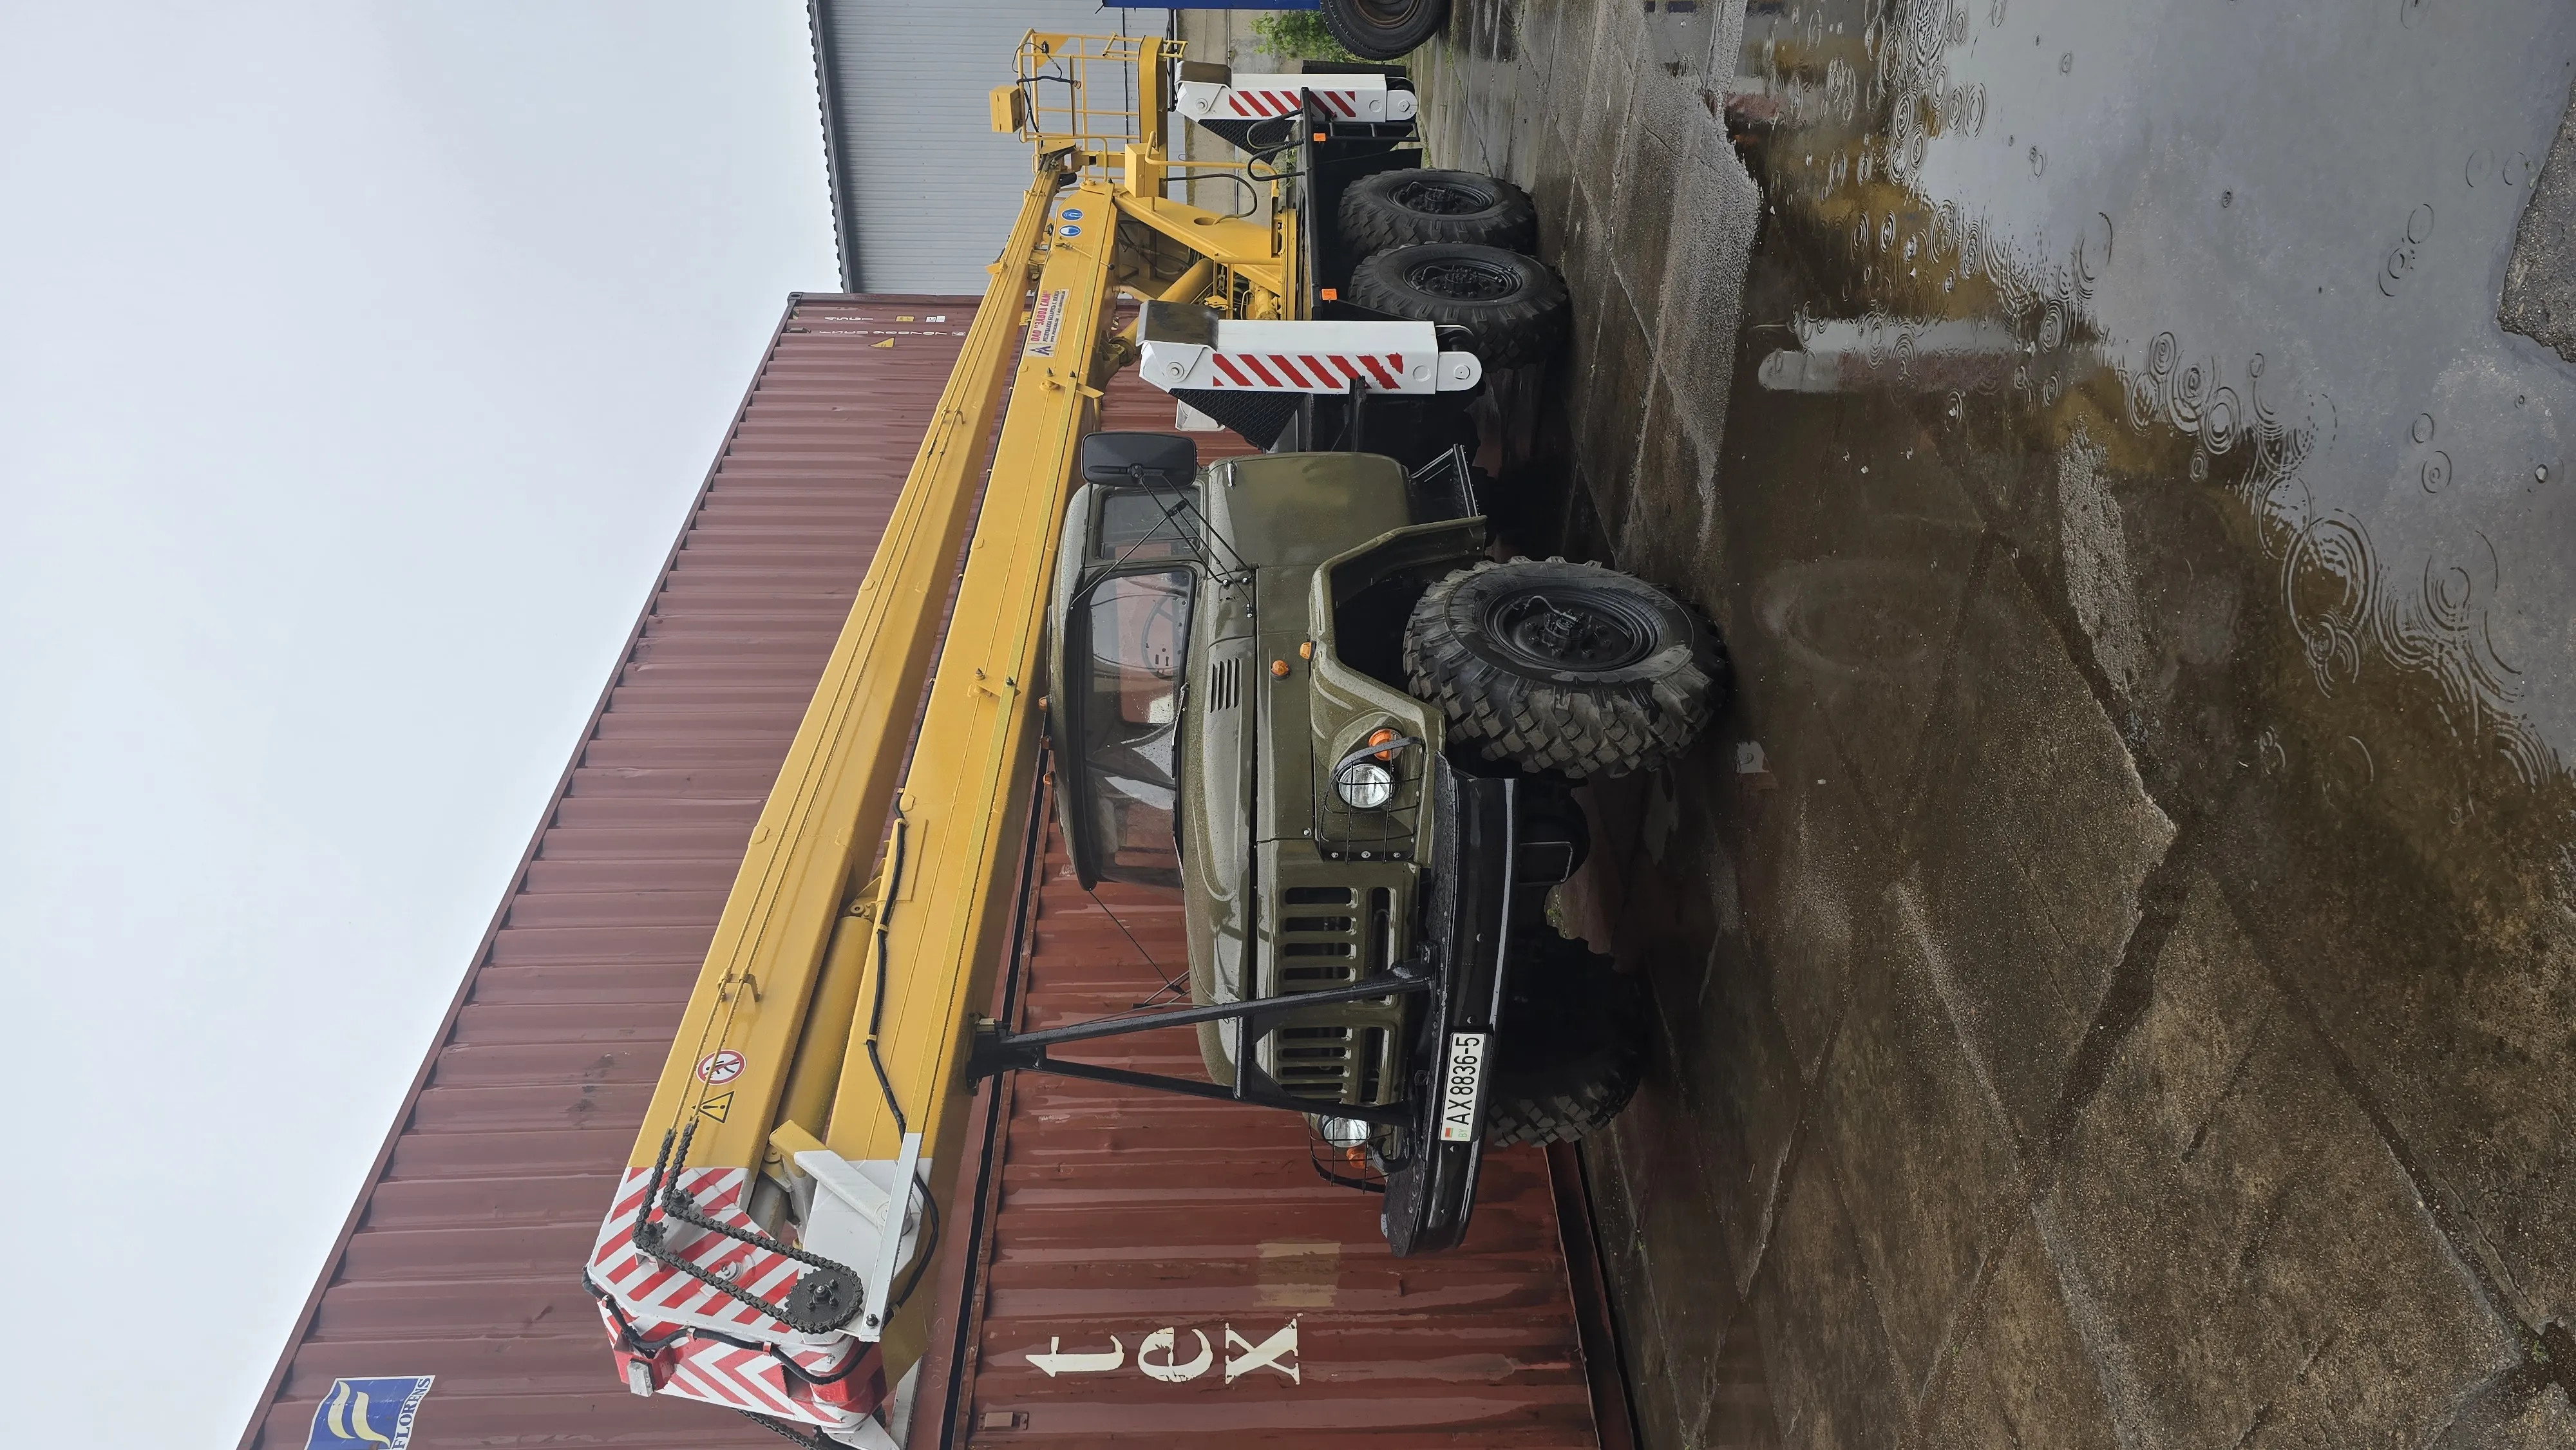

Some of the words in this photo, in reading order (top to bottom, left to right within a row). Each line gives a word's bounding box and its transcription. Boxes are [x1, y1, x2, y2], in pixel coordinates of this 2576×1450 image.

[1030, 330, 1042, 341] ОАО
[1450, 1036, 1480, 1095] 8836-5
[1446, 1098, 1473, 1125] AX
[1457, 1127, 1468, 1138] BY
[392, 1378, 431, 1449] FLORENS
